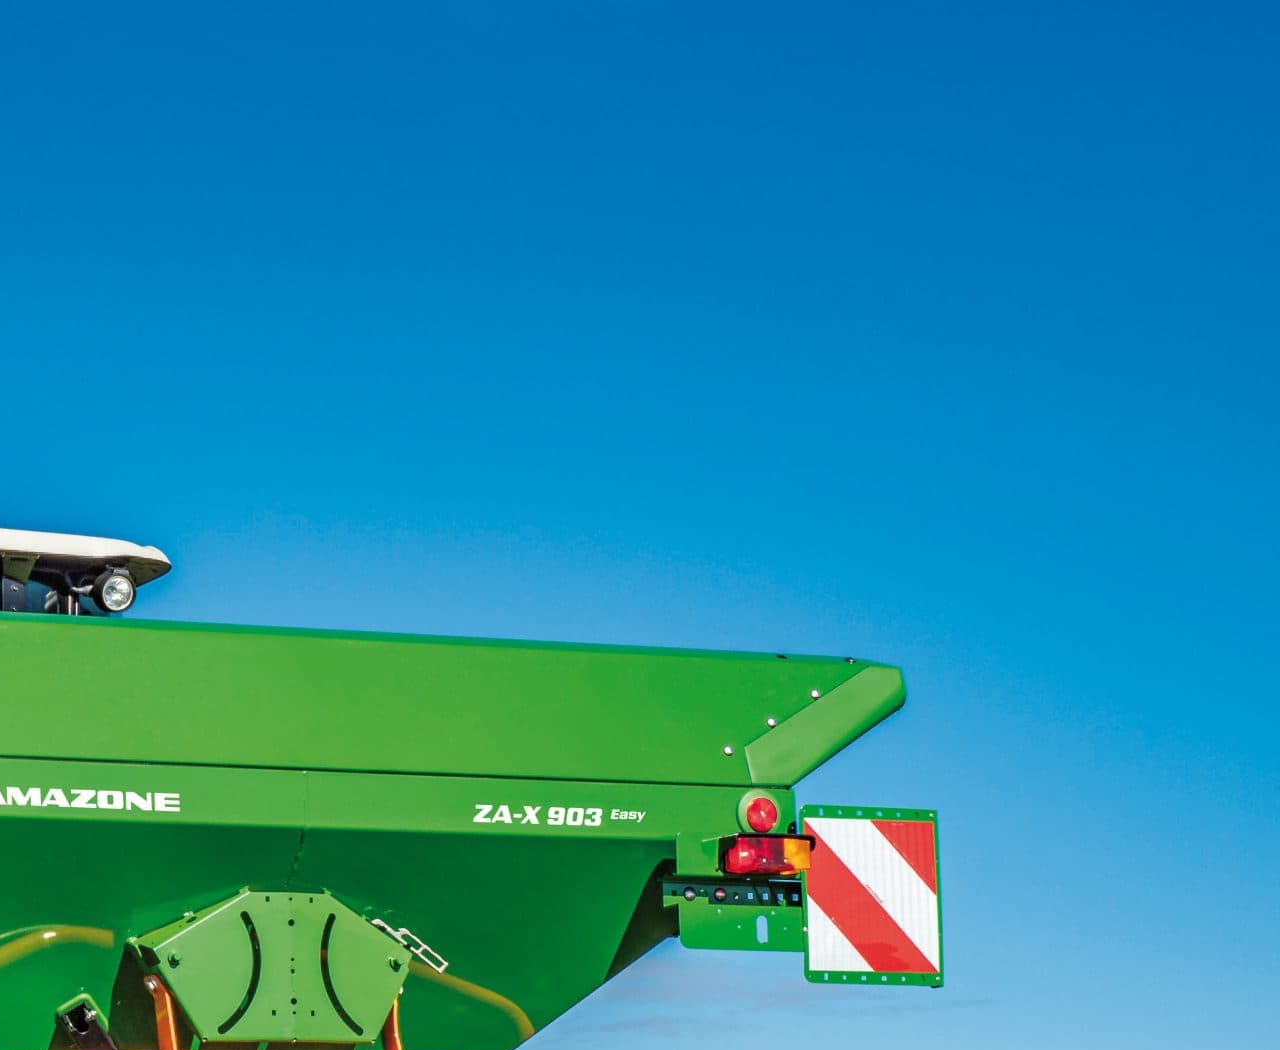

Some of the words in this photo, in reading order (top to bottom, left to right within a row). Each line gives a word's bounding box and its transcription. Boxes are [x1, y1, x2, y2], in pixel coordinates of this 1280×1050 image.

[472, 804, 542, 825] ZA-X
[547, 806, 603, 827] 903
[610, 809, 646, 823] Easy
